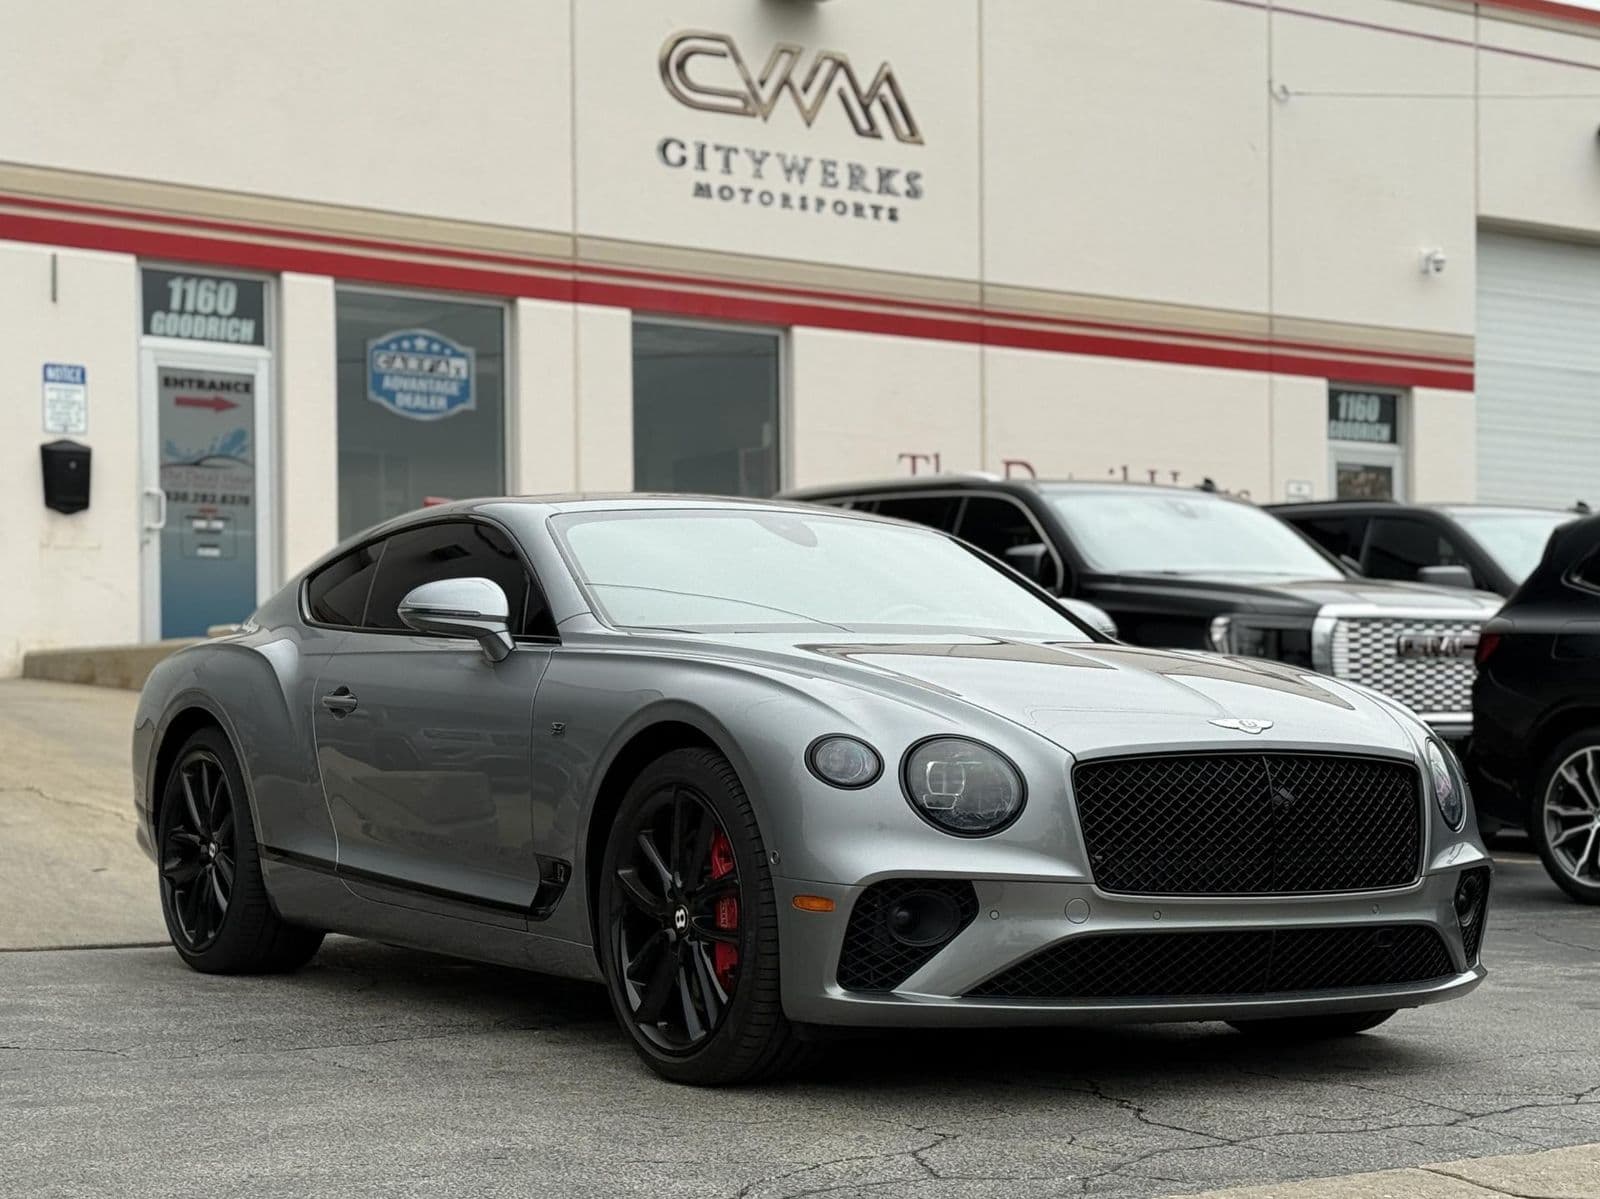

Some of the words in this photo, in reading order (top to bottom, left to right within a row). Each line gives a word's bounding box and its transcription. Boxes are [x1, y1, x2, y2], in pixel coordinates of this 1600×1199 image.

[656, 136, 924, 200] CITYWERKS
[692, 181, 900, 223] MOTORSPORTS
[167, 275, 238, 317] 1160
[151, 310, 256, 343] GOODRICH
[163, 375, 252, 393] ENTRANCE
[1338, 392, 1381, 422] 1160
